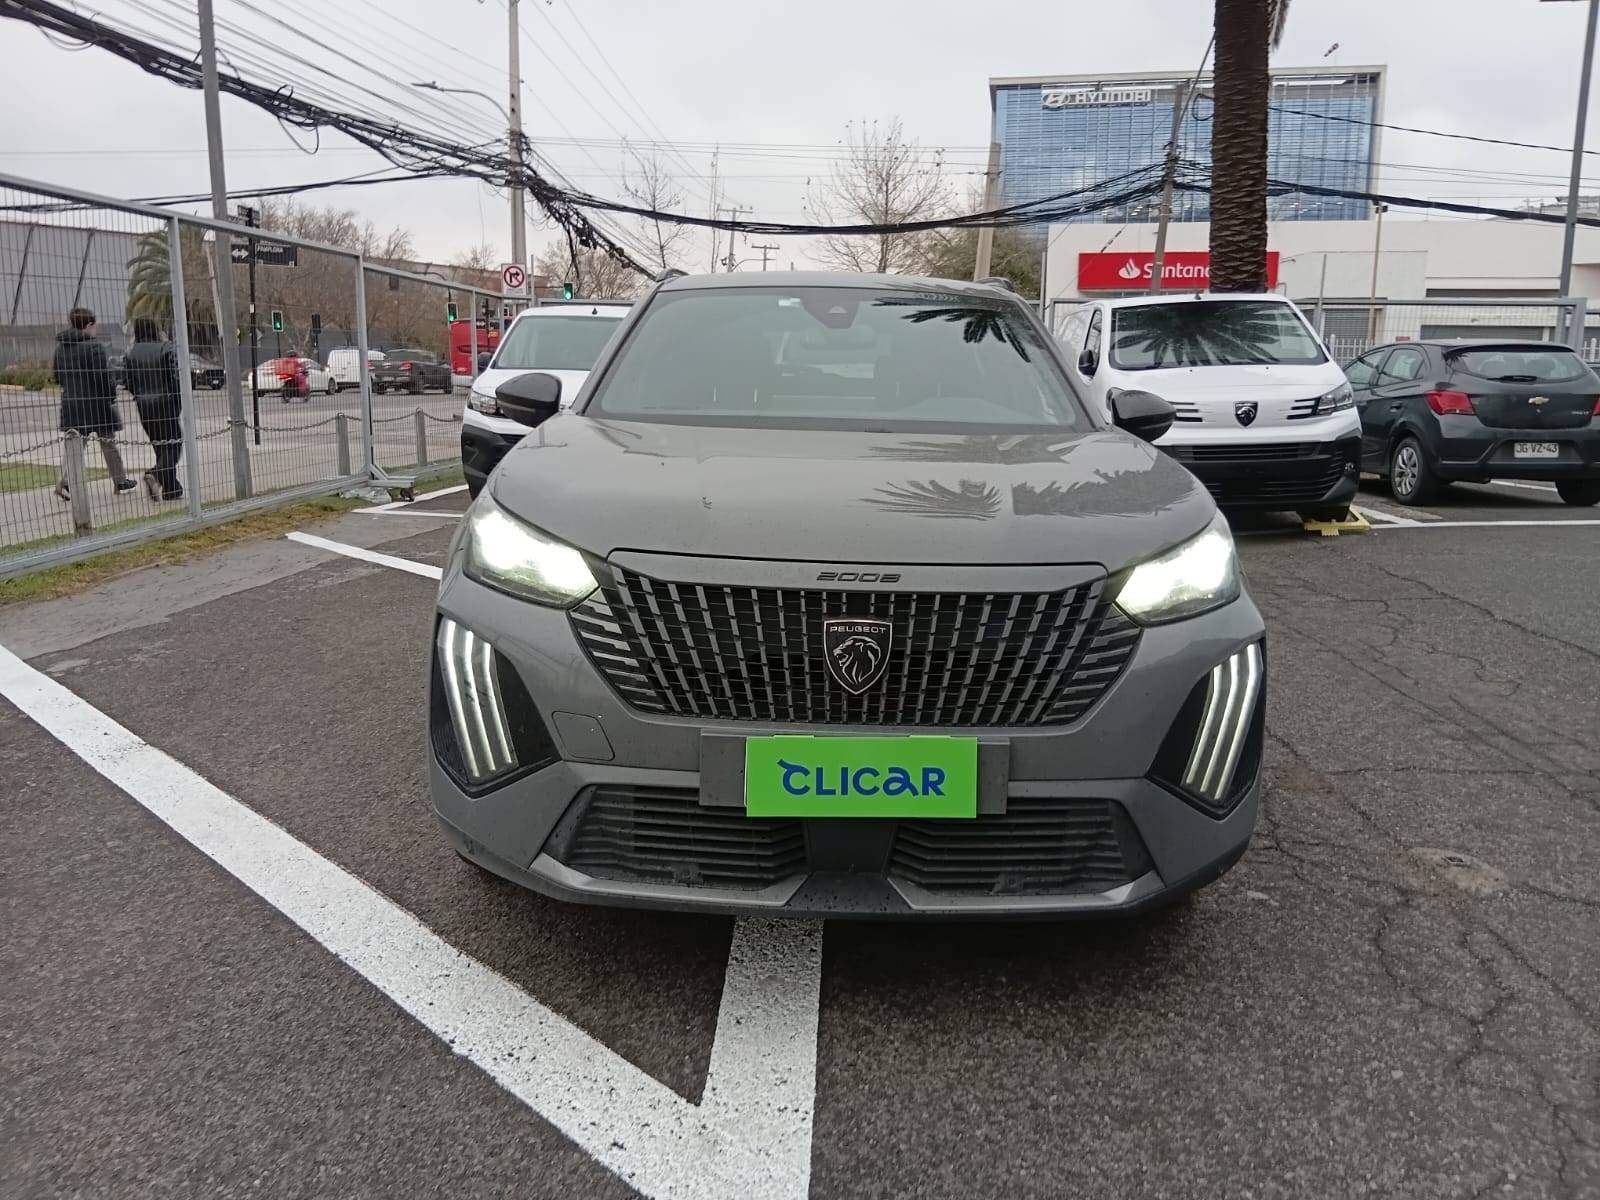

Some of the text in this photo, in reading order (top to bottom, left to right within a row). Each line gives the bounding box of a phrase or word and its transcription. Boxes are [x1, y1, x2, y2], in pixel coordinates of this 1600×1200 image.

[1075, 90, 1151, 103] HYUNDAI
[1142, 262, 1210, 279] Sntan
[816, 571, 901, 583] 2008
[829, 625, 888, 634] PEUGEOT
